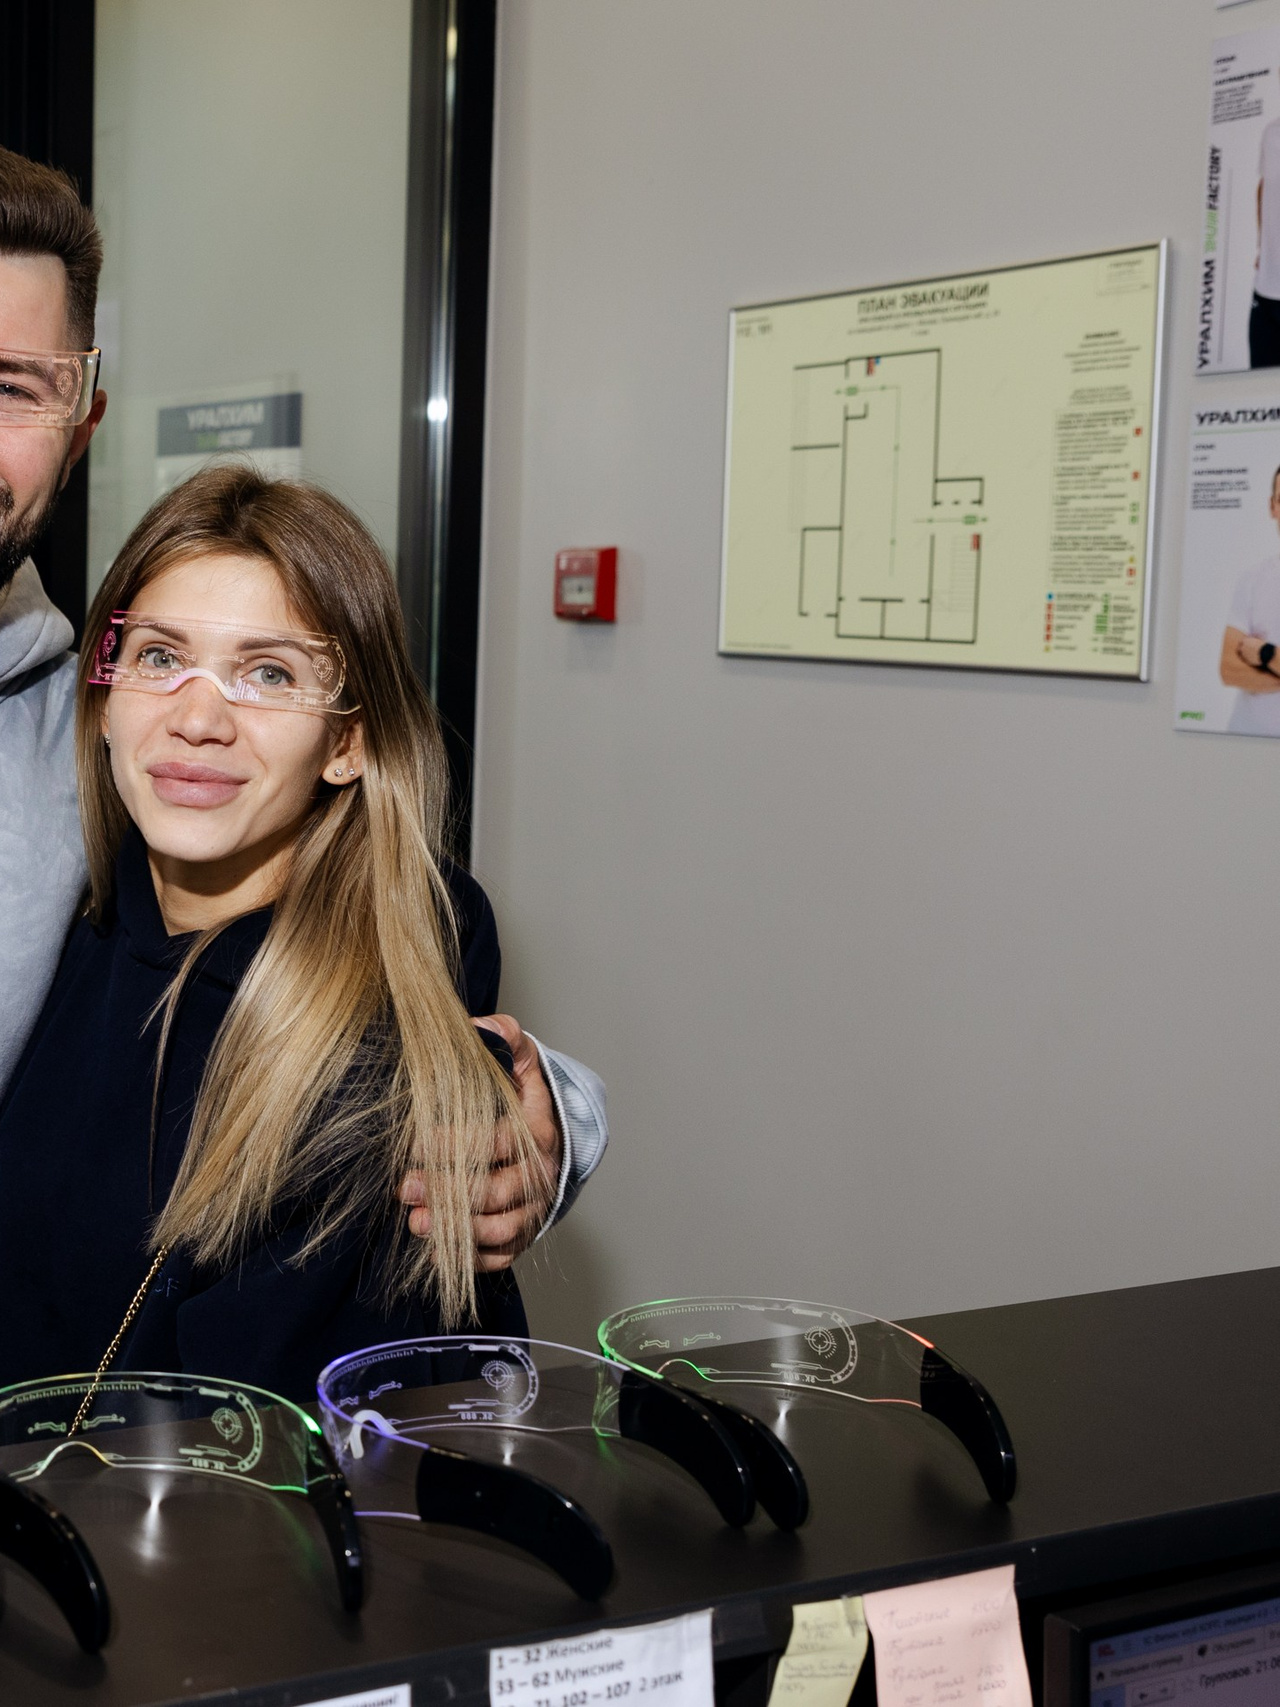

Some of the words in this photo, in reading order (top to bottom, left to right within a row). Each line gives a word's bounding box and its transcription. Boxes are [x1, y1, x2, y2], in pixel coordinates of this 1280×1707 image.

[857, 296, 898, 314] ПЛАН
[901, 283, 990, 309] ЭВАКУАЦИИ
[496, 1656, 504, 1669] 1
[524, 1648, 542, 1665] 32
[546, 1636, 614, 1660] Женские
[495, 1679, 514, 1695] 33
[532, 1673, 550, 1688] 62
[554, 1659, 625, 1684] Мужские
[605, 1682, 631, 1700] 107
[639, 1678, 648, 1693] 2
[650, 1670, 684, 1689] этаж
